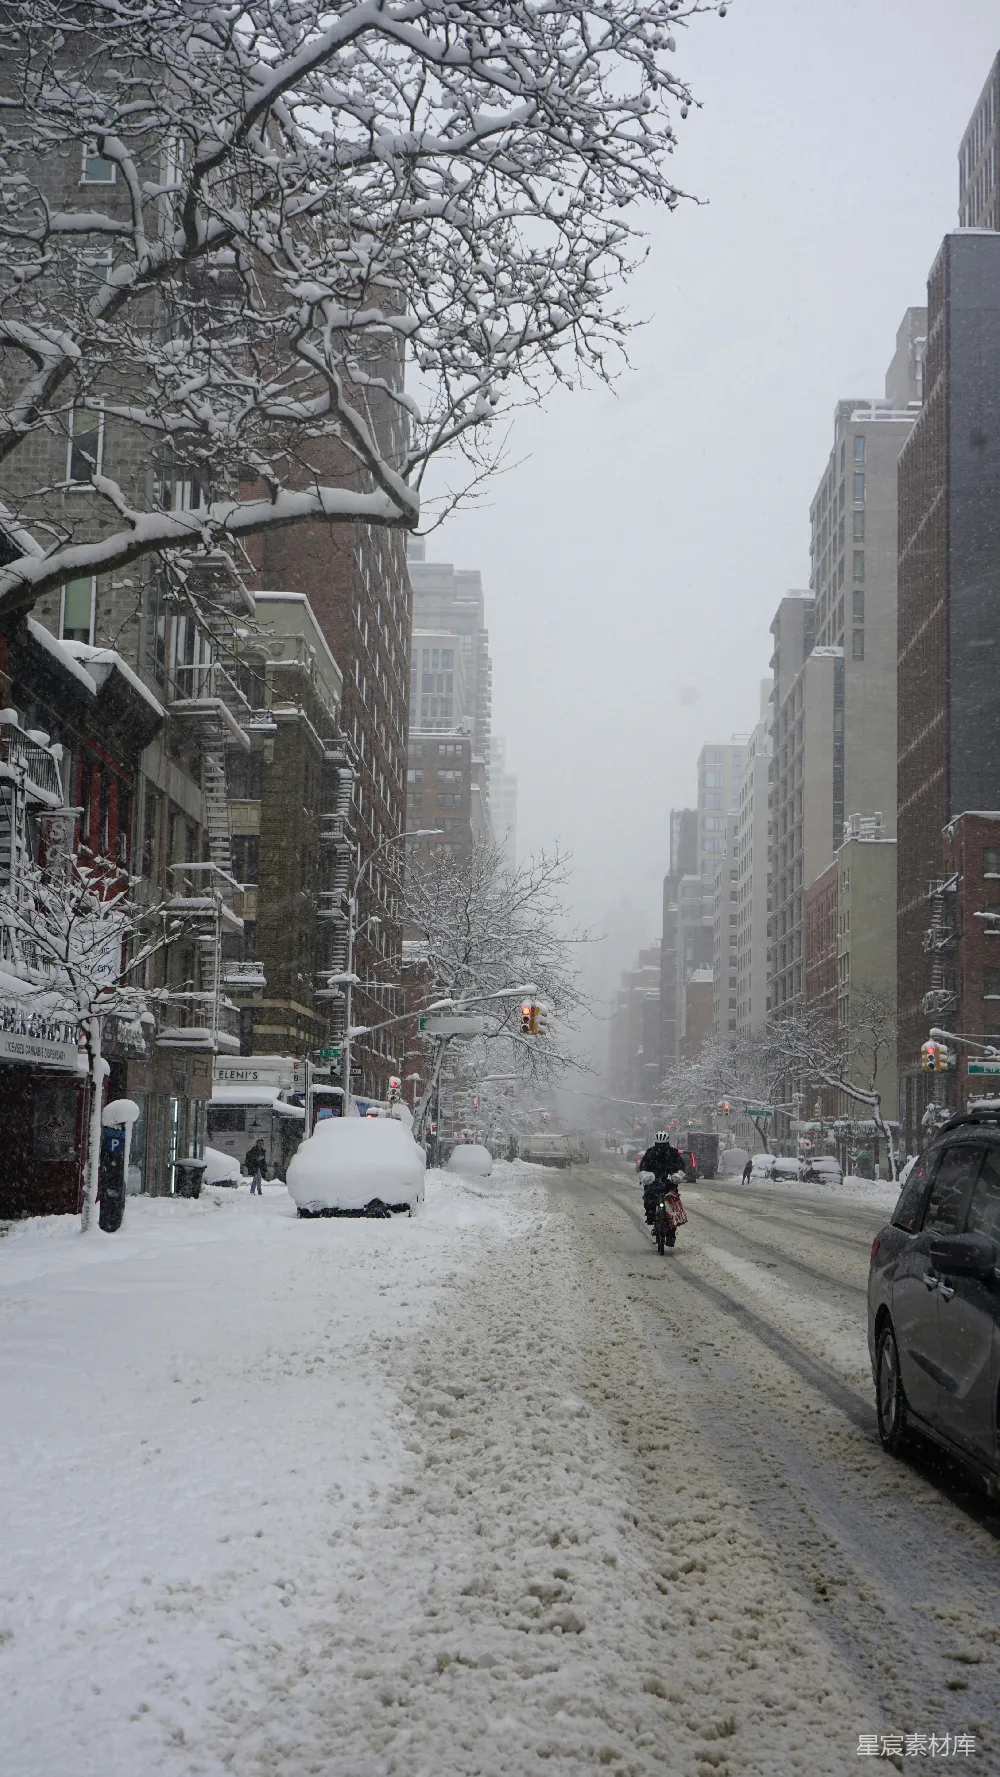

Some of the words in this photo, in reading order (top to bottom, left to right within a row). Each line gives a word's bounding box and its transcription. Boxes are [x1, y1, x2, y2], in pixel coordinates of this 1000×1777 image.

[5, 1041, 25, 1055] LICENSED
[25, 1044, 44, 1058] CANNABIS
[218, 1070, 258, 1080] ELENI'S
[111, 1139, 120, 1152] P
